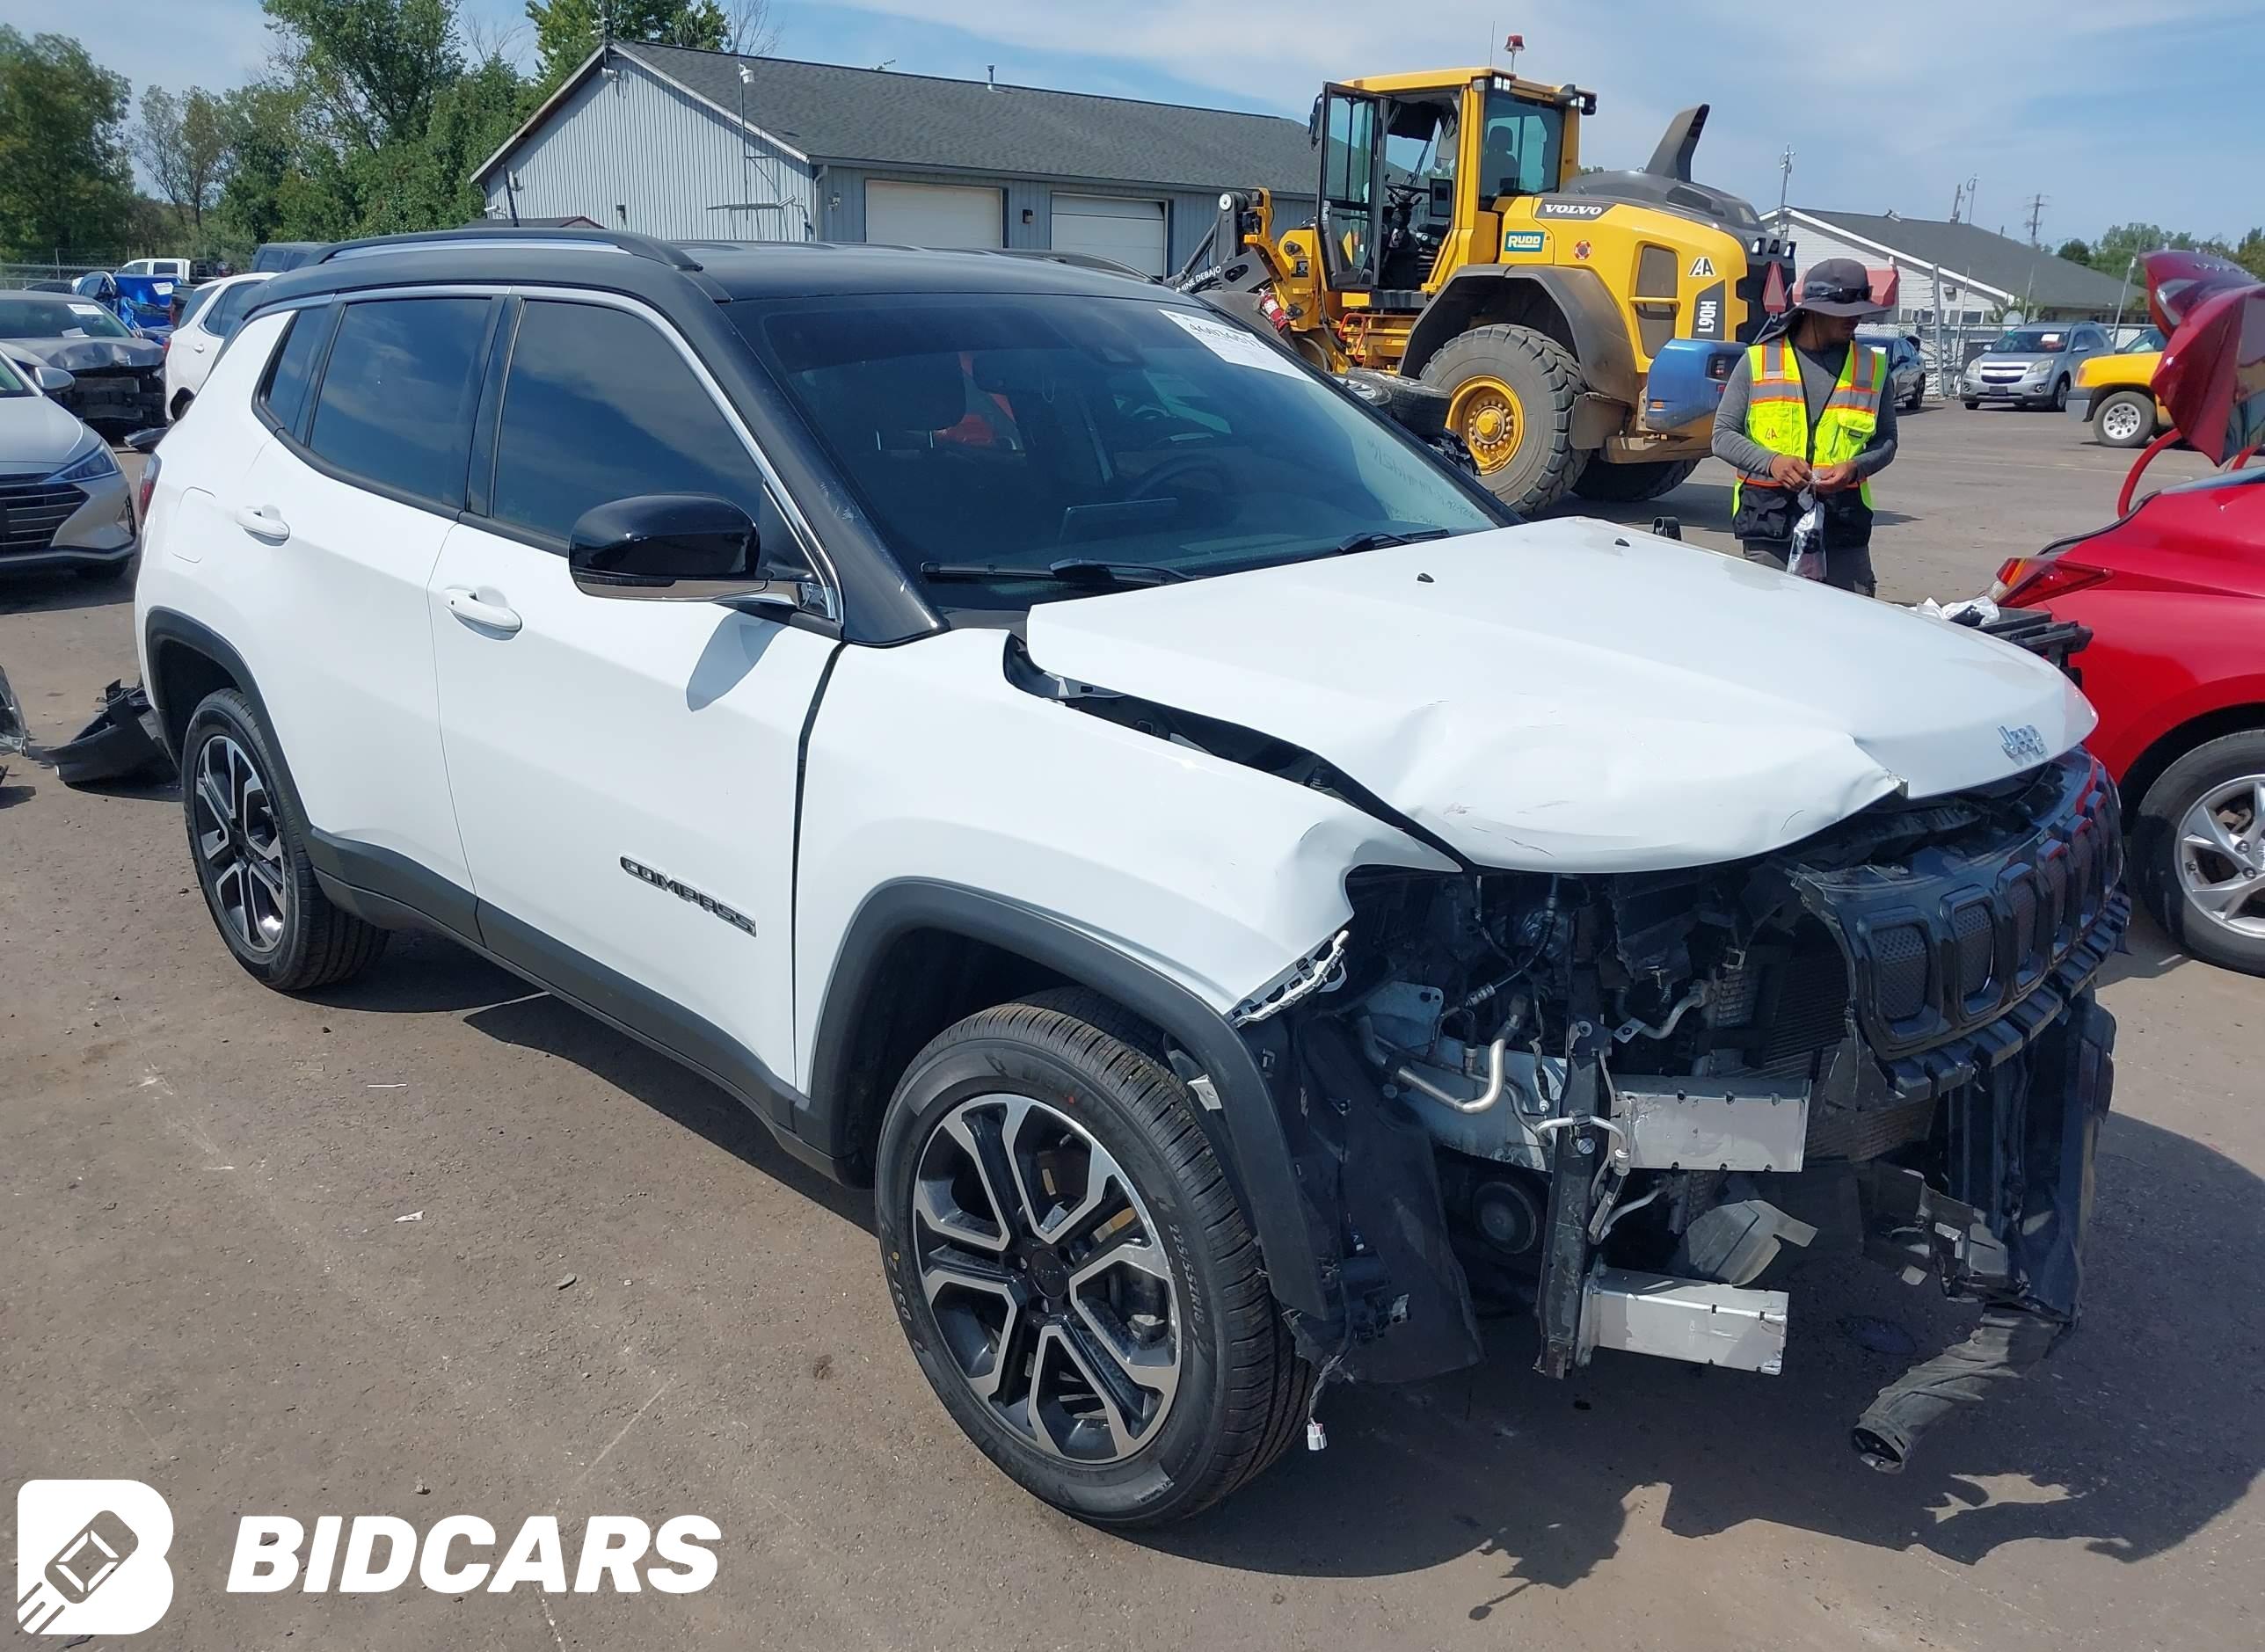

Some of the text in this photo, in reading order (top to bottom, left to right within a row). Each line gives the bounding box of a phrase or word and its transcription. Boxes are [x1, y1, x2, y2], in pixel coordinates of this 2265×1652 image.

[1545, 204, 1603, 215] VOLVO
[1508, 235, 1541, 248] RUDD
[1195, 266, 1222, 282] DEBAJO
[1697, 301, 1717, 333] L90H
[619, 855, 758, 938] COMPASS
